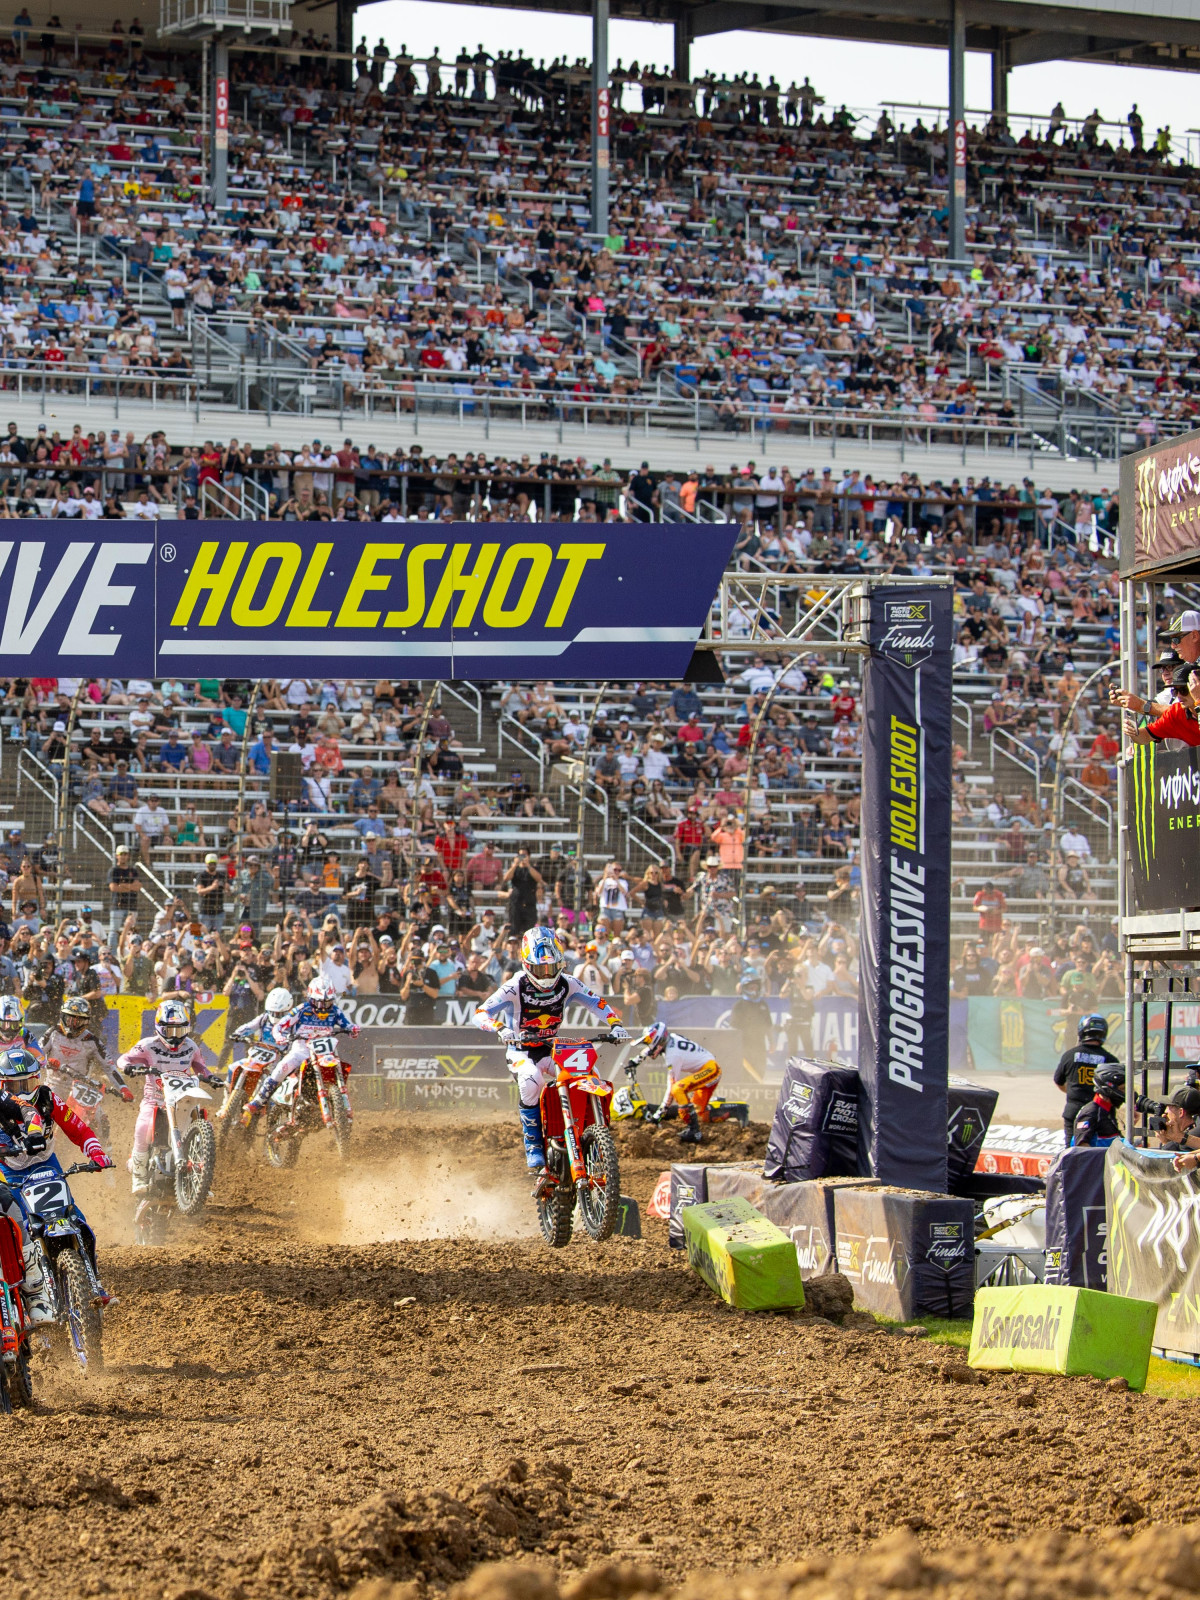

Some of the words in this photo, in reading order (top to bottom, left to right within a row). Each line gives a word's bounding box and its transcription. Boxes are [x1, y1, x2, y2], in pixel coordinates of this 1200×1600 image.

[217, 81, 228, 126] 101
[598, 89, 609, 134] 401
[955, 121, 966, 165] 402
[170, 541, 607, 629] HOLESHOT
[879, 624, 935, 651] Finals
[890, 714, 921, 852] HOLESHOT
[888, 859, 926, 1092] PROGRESSIVE
[312, 1039, 334, 1054] 51
[563, 1049, 590, 1071] 4
[382, 1058, 440, 1070] SUPER
[386, 1070, 437, 1079] MOTO
[414, 1083, 500, 1100] MONSTER
[782, 1096, 813, 1118] Finals
[33, 1182, 65, 1213] 2
[861, 1234, 895, 1285] Finals
[925, 1240, 966, 1258] Finals
[978, 1304, 1062, 1352] Kawasaki
